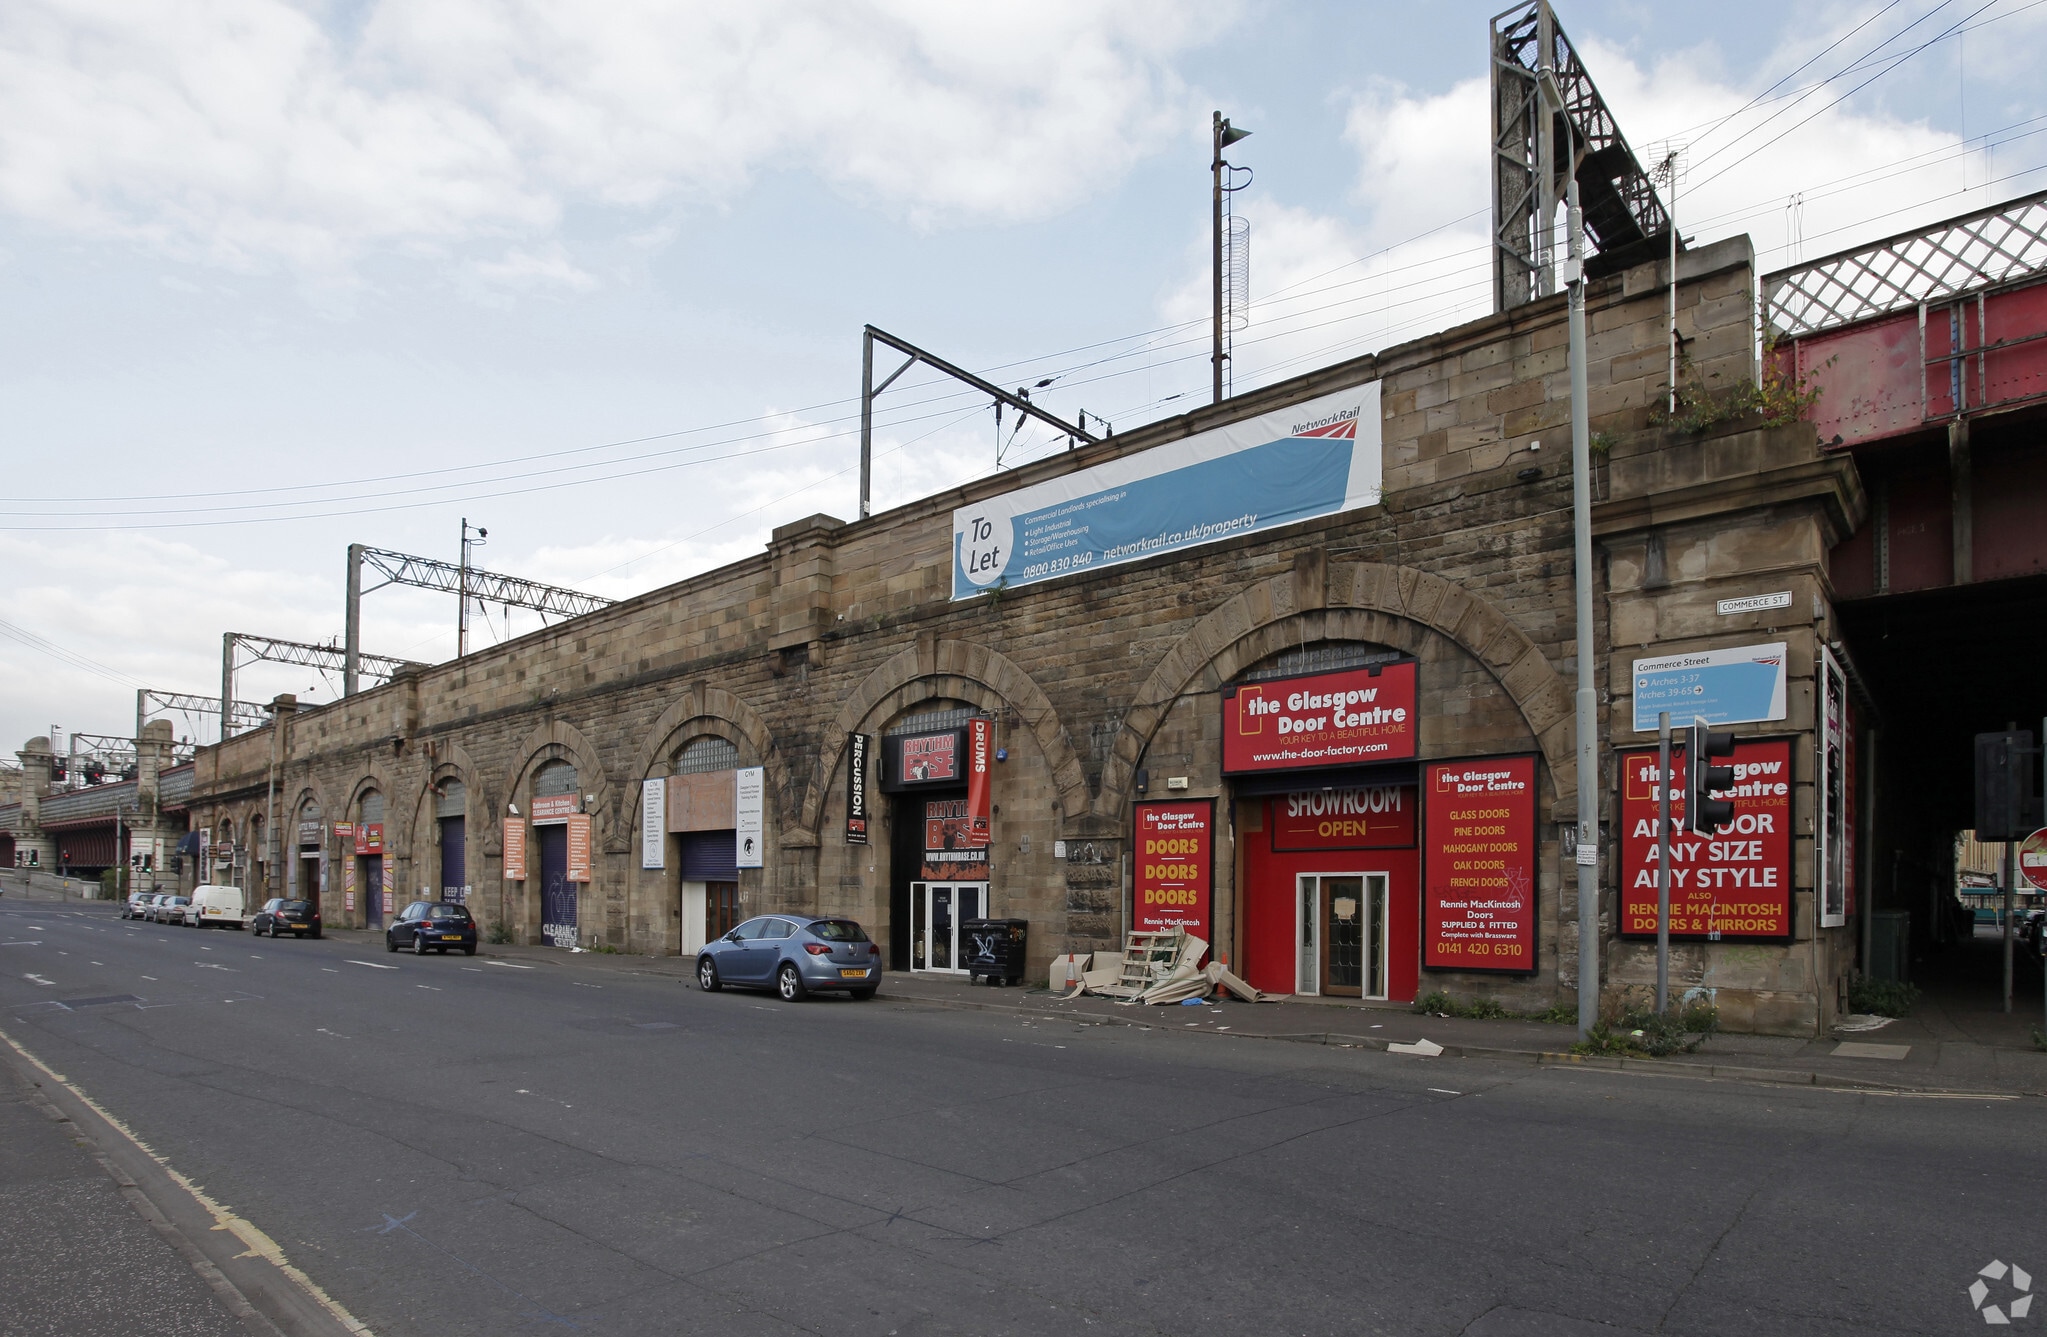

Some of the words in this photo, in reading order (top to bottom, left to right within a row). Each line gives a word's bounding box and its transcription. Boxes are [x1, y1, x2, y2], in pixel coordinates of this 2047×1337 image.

[1024, 509, 1058, 525] Commercial
[1058, 502, 1085, 516] Landlords
[1086, 494, 1120, 510] specialising
[972, 516, 992, 543] To
[1030, 526, 1044, 542] Light
[1045, 518, 1072, 532] Industrial
[1030, 525, 1089, 546] Storage/Warehousing
[1103, 513, 1258, 560] networkrail.co.uk/property
[1030, 542, 1063, 556] Retail/Office
[1064, 538, 1078, 548] Uses
[969, 546, 1000, 574] Let
[1023, 562, 1049, 579] 0800
[1050, 556, 1070, 573] 830
[1072, 551, 1092, 568] 840
[1722, 598, 1769, 611] COMMERCE
[1772, 596, 1787, 604] ST.
[1638, 660, 1682, 672] Commerce
[1684, 657, 1710, 666] Street
[1651, 676, 1678, 687] Arches
[1681, 674, 1700, 684] 3-37
[1638, 689, 1666, 700] Arches
[1668, 687, 1692, 696] 39-65
[1249, 697, 1280, 716] the
[1287, 688, 1378, 711] Glasgow
[1278, 716, 1326, 734] Door
[1333, 707, 1406, 728] Centre
[1279, 736, 1299, 745] YOUR
[1301, 734, 1316, 743] KEY
[1318, 733, 1328, 741] TO
[1329, 731, 1336, 740] A
[1337, 727, 1379, 739] BEAUTIFUL
[1381, 724, 1406, 734] HOME
[904, 734, 954, 753] RHYTHM
[975, 722, 986, 773] DRUMS
[1253, 742, 1388, 761] www.the-door-factory.com
[852, 734, 864, 816] PERCUSSION
[1442, 773, 1460, 782] the
[1463, 771, 1511, 782] Glasgow
[1457, 783, 1484, 793] Door
[1487, 781, 1525, 791] Centre
[926, 800, 969, 818] RHYTH
[1287, 786, 1400, 817] SHOWROOM
[1761, 798, 1787, 806] HOME
[533, 808, 554, 816] CLEARANCE
[555, 807, 570, 815] CENTRE
[1161, 812, 1195, 822] Glasgow
[1450, 810, 1477, 820] GLASS
[1478, 809, 1510, 819] DOORS
[1158, 822, 1176, 830] Door
[1178, 820, 1204, 829] Centre
[1318, 820, 1366, 837] OPEN
[1454, 827, 1472, 836] PINE
[1474, 826, 1505, 836] DOORS
[1146, 838, 1199, 854] DOORS
[1443, 844, 1488, 853] MAHOGANY
[1490, 842, 1518, 852] DOORS
[1645, 843, 1702, 862] ANY
[1708, 840, 1762, 861] SIZE
[1145, 864, 1198, 880] DOORS
[1453, 861, 1472, 870] OAK
[1474, 860, 1505, 870] DOORS
[1450, 878, 1479, 887] FRENCH
[1481, 878, 1508, 887] DOORS
[1696, 868, 1777, 888] STYLE
[1144, 889, 1197, 905] DOORS
[1440, 900, 1468, 908] Rennie
[1470, 900, 1521, 908] MacKintosh
[1467, 911, 1493, 919] Doors
[1629, 904, 1681, 915] RENIE
[1686, 904, 1782, 915] MACINTOSH
[1165, 917, 1200, 926] MacKintosh
[1633, 919, 1687, 930] DORS
[1692, 919, 1702, 930] &
[1708, 919, 1777, 931] MIRRORS
[1437, 942, 1462, 953] 0141
[1468, 943, 1490, 954] 420
[1494, 944, 1522, 955] 6310
